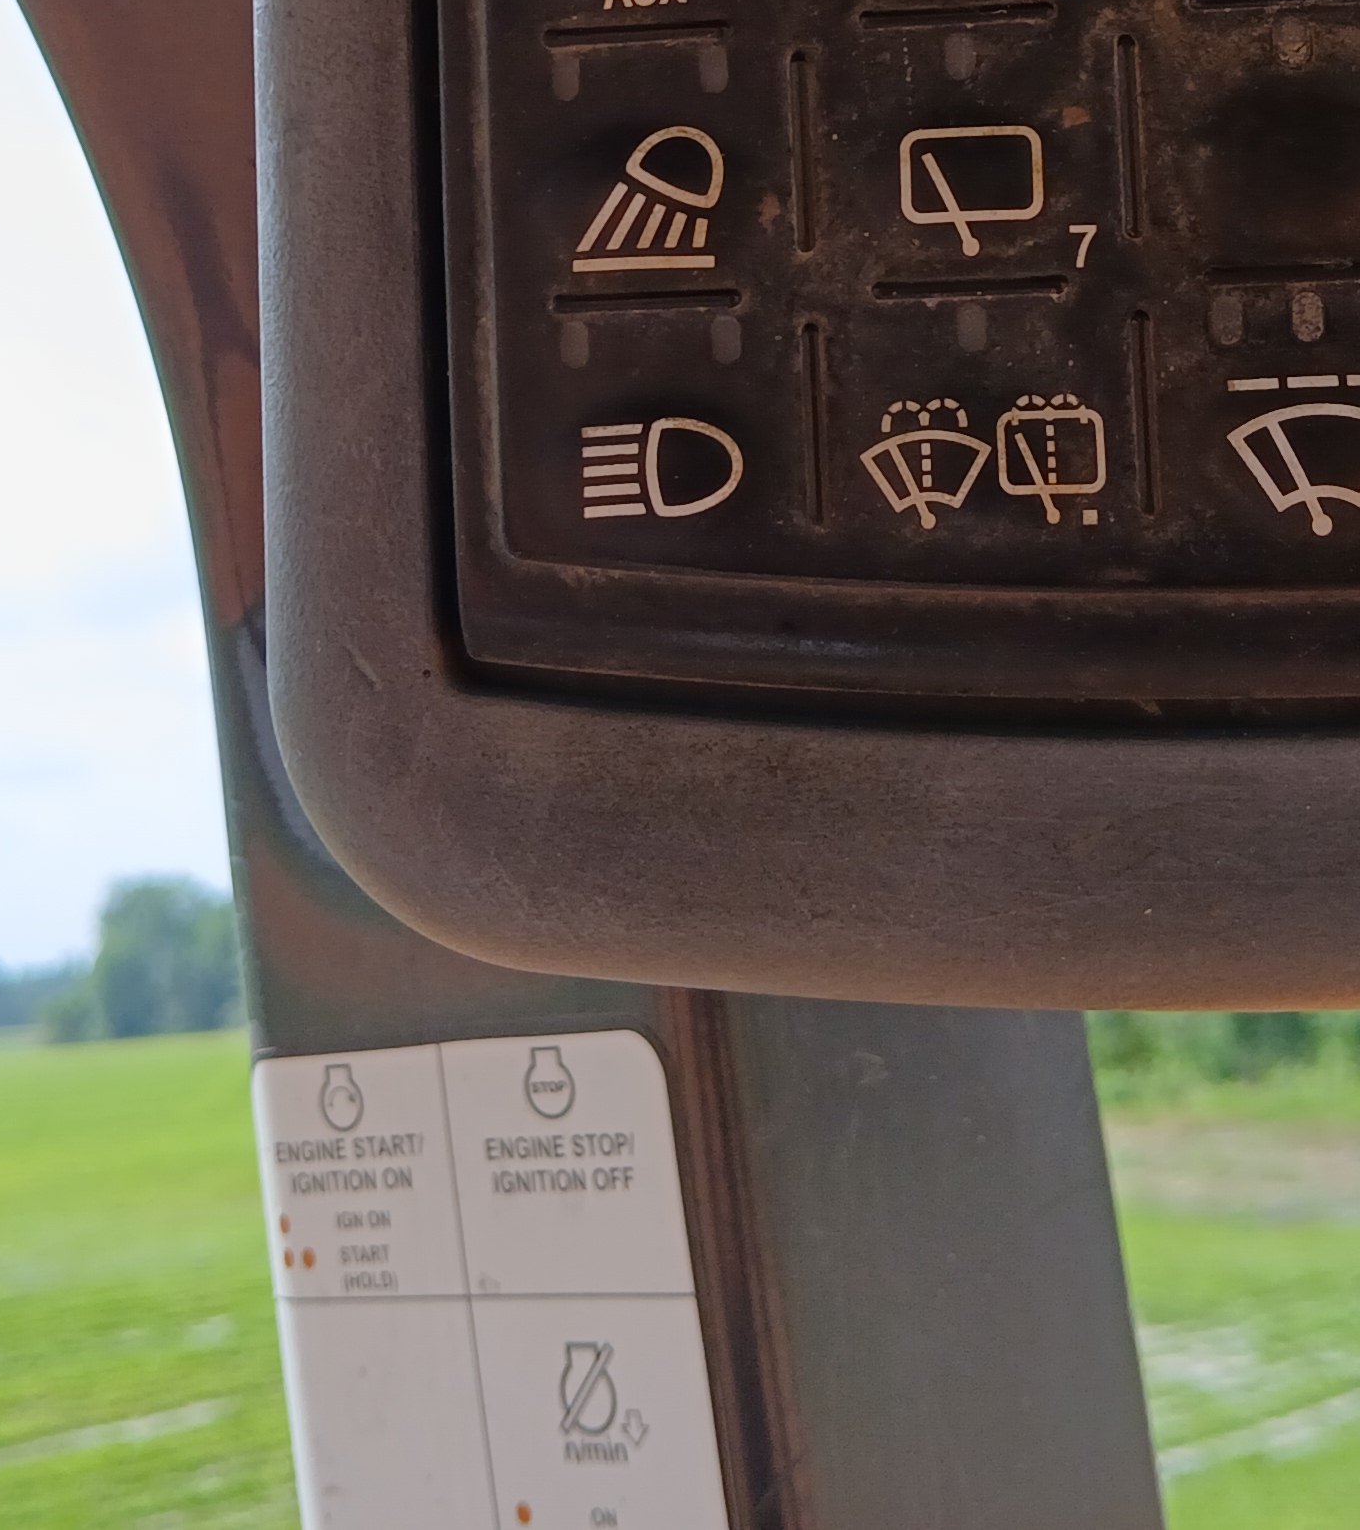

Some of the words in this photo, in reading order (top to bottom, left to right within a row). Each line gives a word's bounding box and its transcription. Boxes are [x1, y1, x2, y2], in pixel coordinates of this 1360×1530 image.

[1068, 224, 1097, 268] 7
[276, 1138, 348, 1164] ENGINE
[485, 1135, 565, 1161] ENGINE
[292, 1169, 377, 1194] IGNITION
[383, 1166, 413, 1190] ON
[493, 1169, 587, 1193] IGNITION
[592, 1166, 634, 1191] OFF
[336, 1210, 363, 1228] IGN
[367, 1210, 391, 1227] ON
[340, 1243, 389, 1265] START
[590, 1506, 618, 1527] ON
